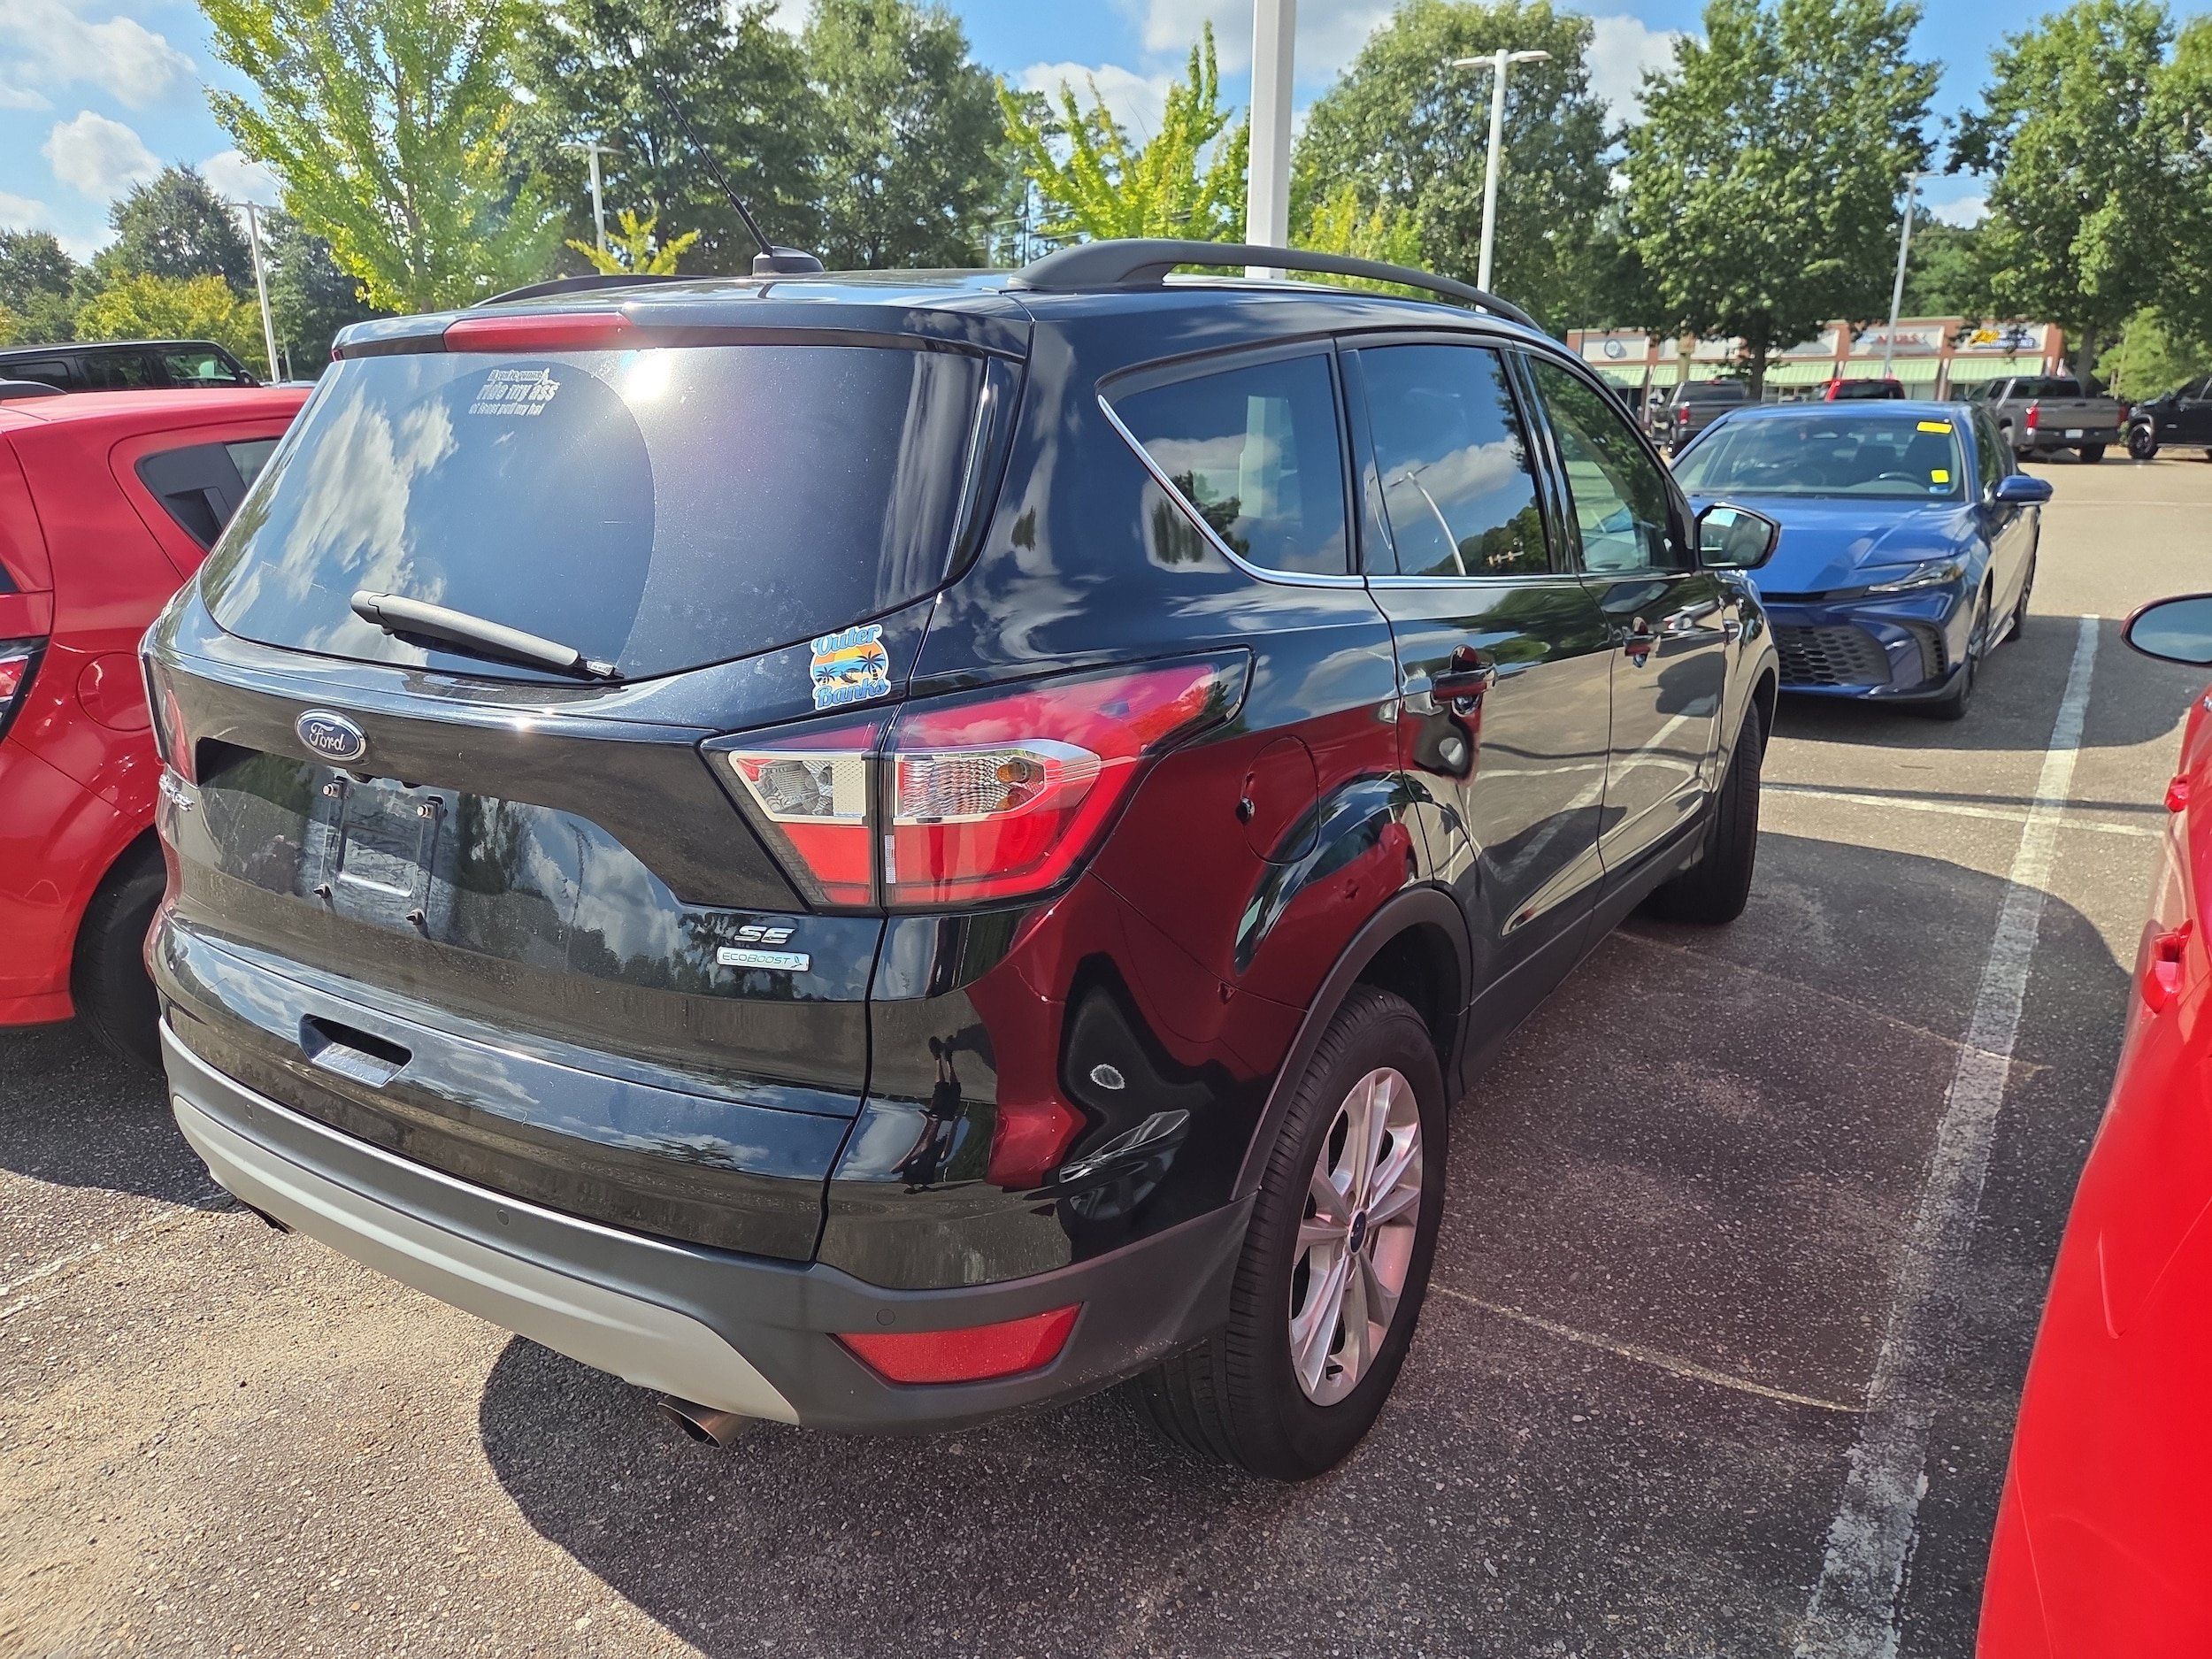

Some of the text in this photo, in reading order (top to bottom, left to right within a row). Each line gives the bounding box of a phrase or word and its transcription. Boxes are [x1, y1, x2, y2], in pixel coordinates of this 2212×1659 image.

[476, 381, 559, 402] ride my ass
[812, 626, 880, 656] Outer
[814, 678, 888, 708] Banks
[309, 722, 346, 752] Ford
[733, 925, 795, 944] SE
[722, 952, 790, 964] ECOBOOST
